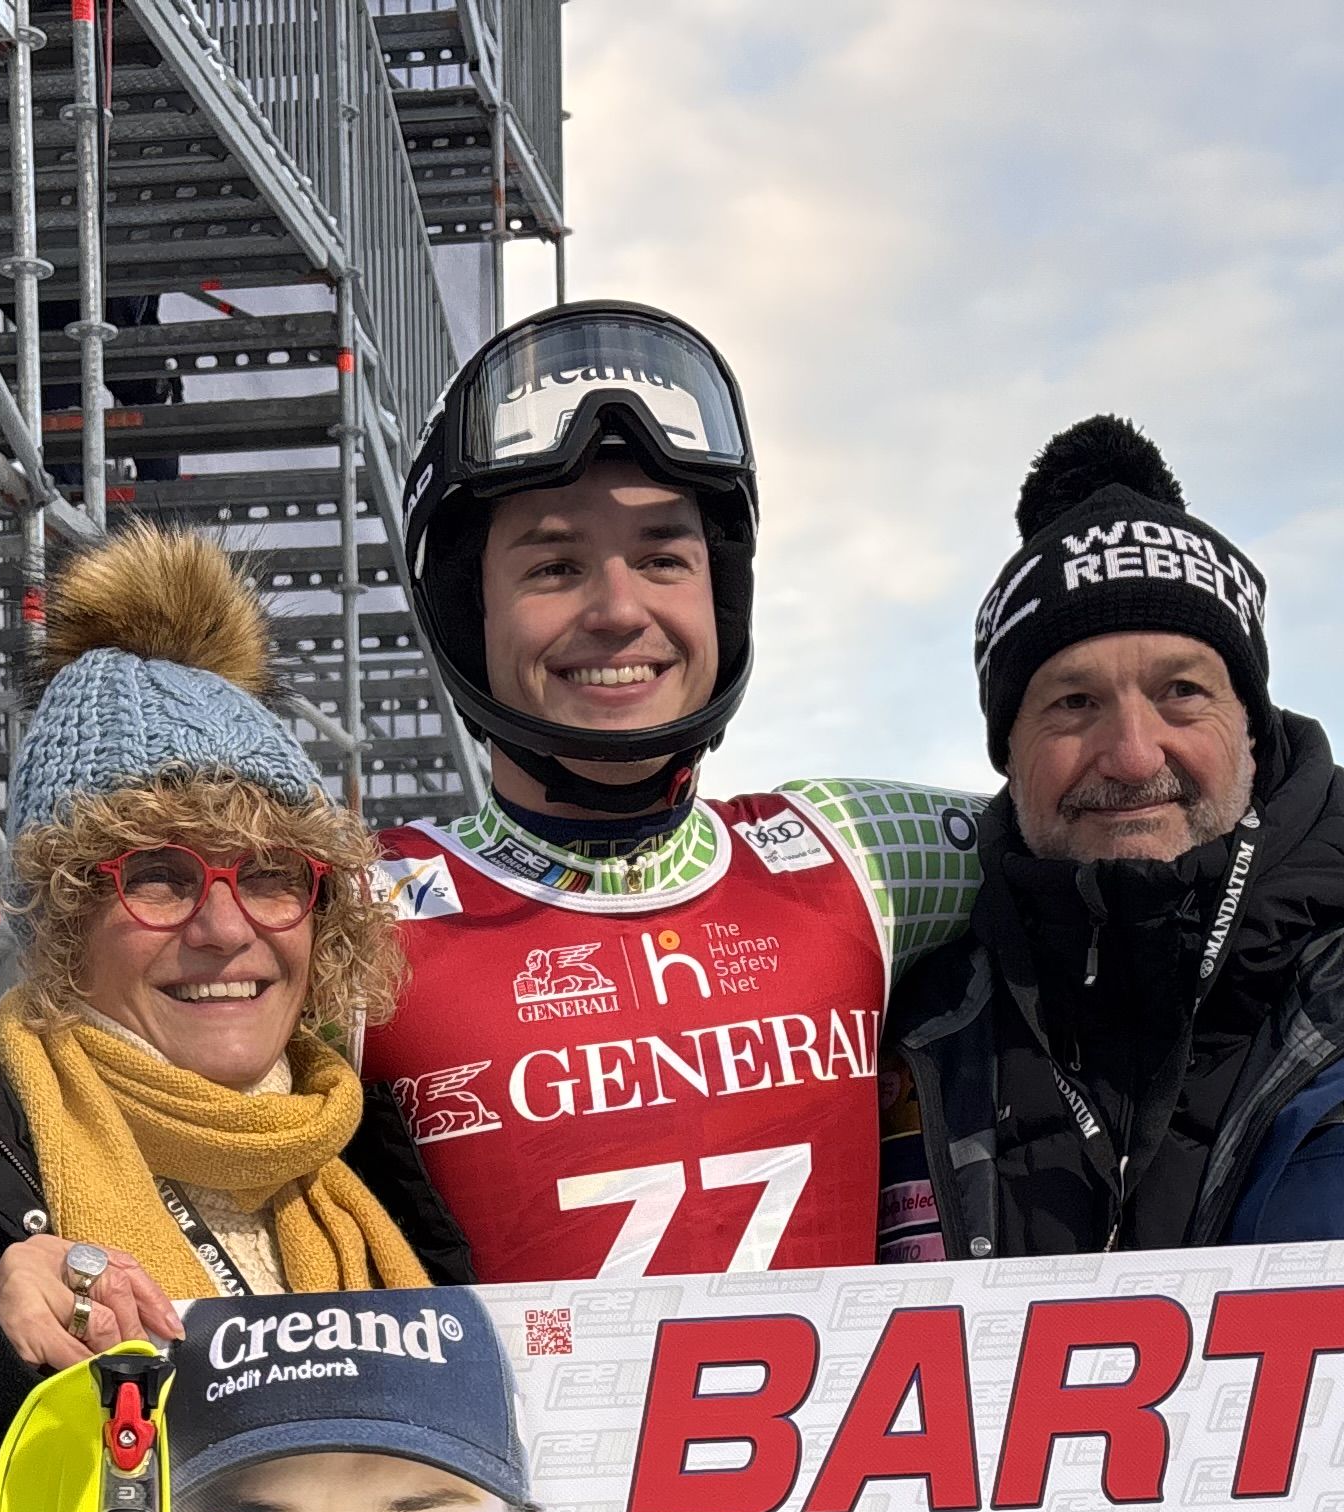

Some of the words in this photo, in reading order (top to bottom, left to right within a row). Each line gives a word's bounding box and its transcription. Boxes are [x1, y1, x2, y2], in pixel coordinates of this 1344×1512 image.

[1062, 520, 1248, 596] WORLD
[1203, 841, 1255, 960] MANDATUM
[701, 921, 740, 940] The
[708, 935, 780, 958] Human
[713, 955, 779, 977] Safety
[719, 976, 759, 995] Net
[517, 995, 621, 1023] GENERALI
[556, 1142, 812, 1279] 77
[206, 1370, 261, 1401] Crèdit
[266, 1357, 359, 1385] Andorrà
